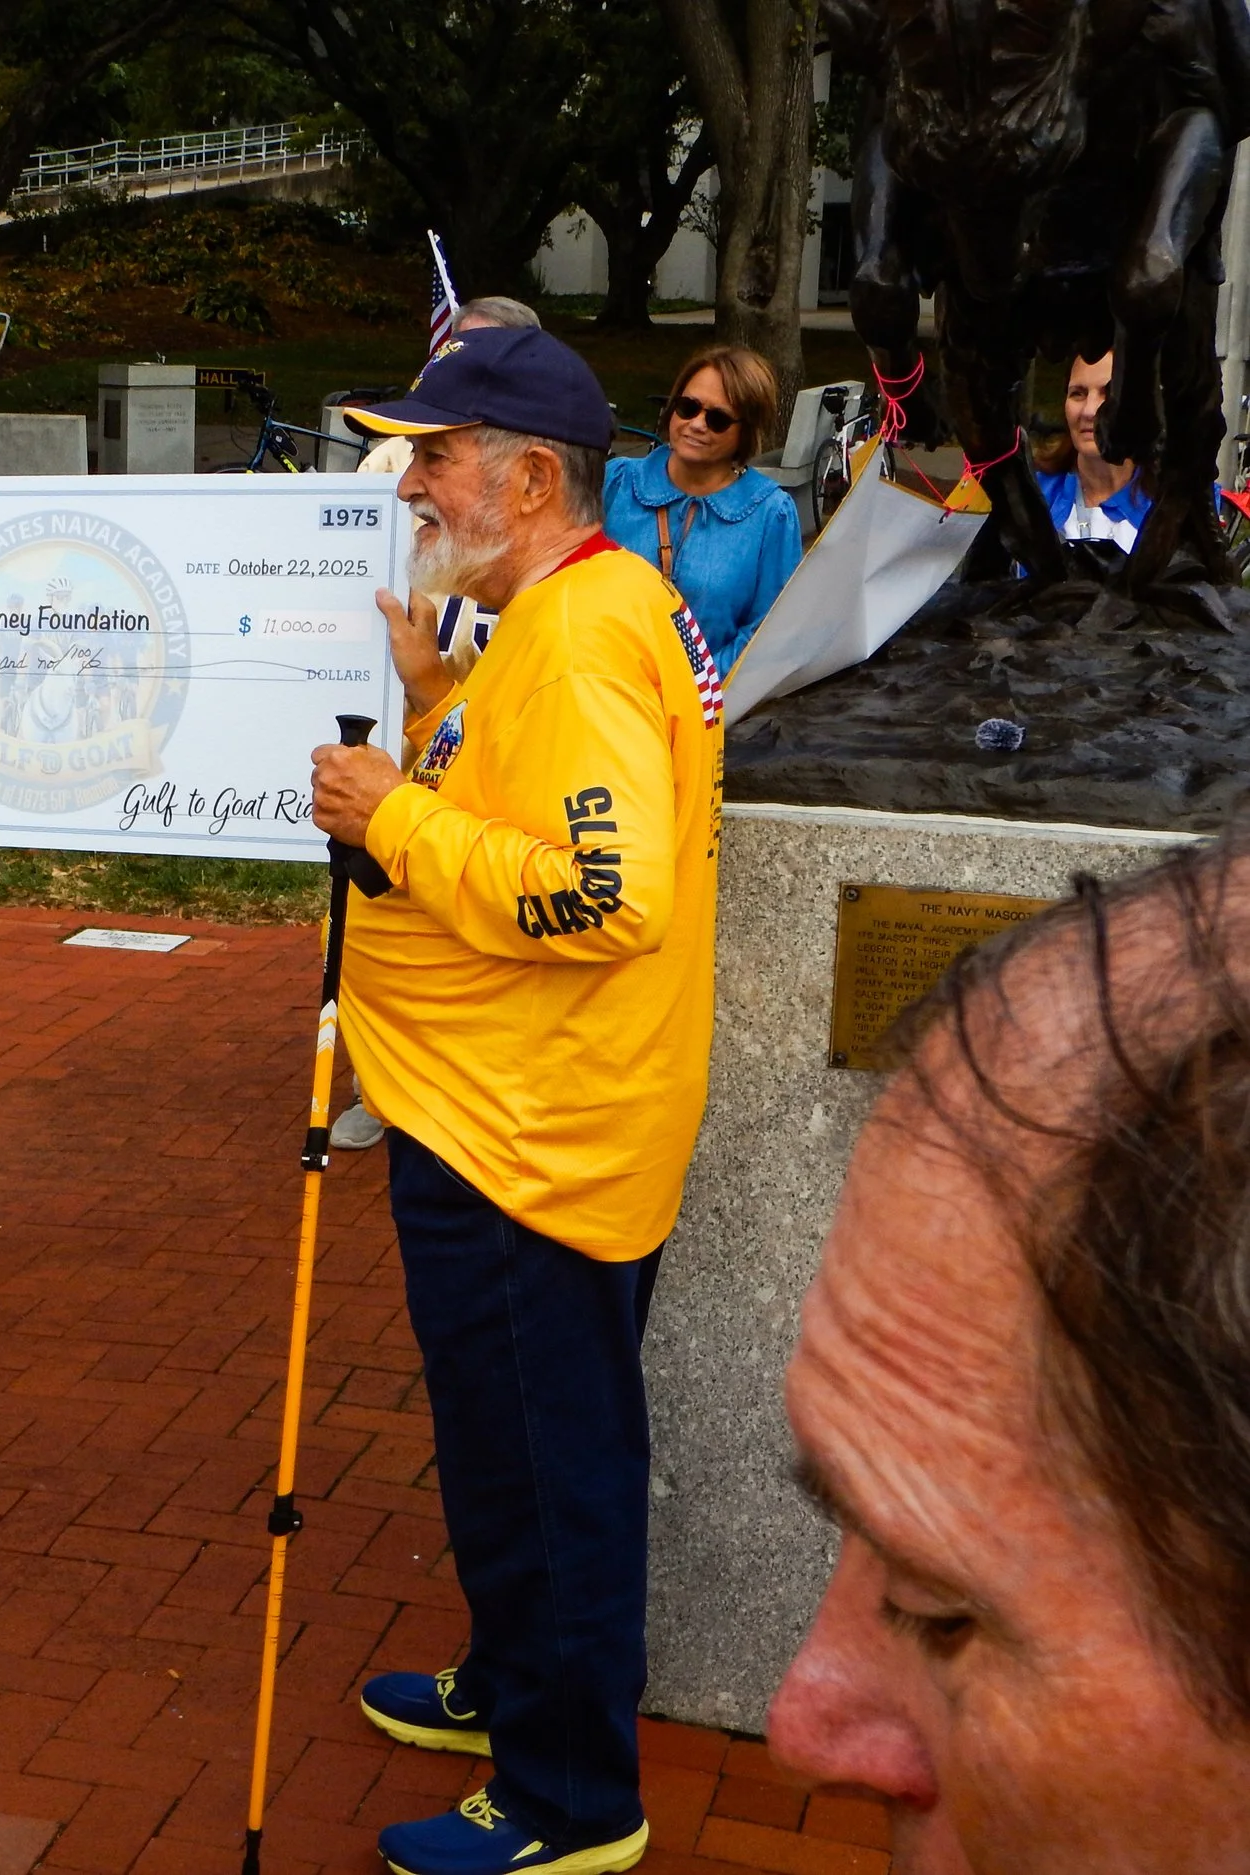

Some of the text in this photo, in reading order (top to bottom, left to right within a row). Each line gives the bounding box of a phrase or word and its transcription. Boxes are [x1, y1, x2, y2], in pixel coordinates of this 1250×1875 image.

[201, 372, 238, 384] HALL
[321, 508, 379, 527] 1975
[186, 563, 220, 575] DATE
[229, 558, 284, 577] October
[51, 513, 121, 551] NAVAL
[124, 547, 187, 659] ACADEMY
[38, 605, 150, 633] Foundation
[263, 617, 337, 636] 11,000.00
[307, 669, 371, 682] DOLLARS
[67, 731, 135, 772] GOAT
[419, 771, 441, 784] GOAT
[118, 781, 314, 835] Gulf to Goat Ri
[920, 903, 942, 915] THE
[947, 905, 980, 917] NAVY
[872, 919, 890, 929] THE
[894, 921, 926, 932] NAVAL
[931, 924, 978, 936] ACADEMY
[878, 932, 918, 944] MASCOT
[923, 935, 950, 947] SINCE
[904, 946, 917, 956] ON
[923, 949, 951, 959] THEIR
